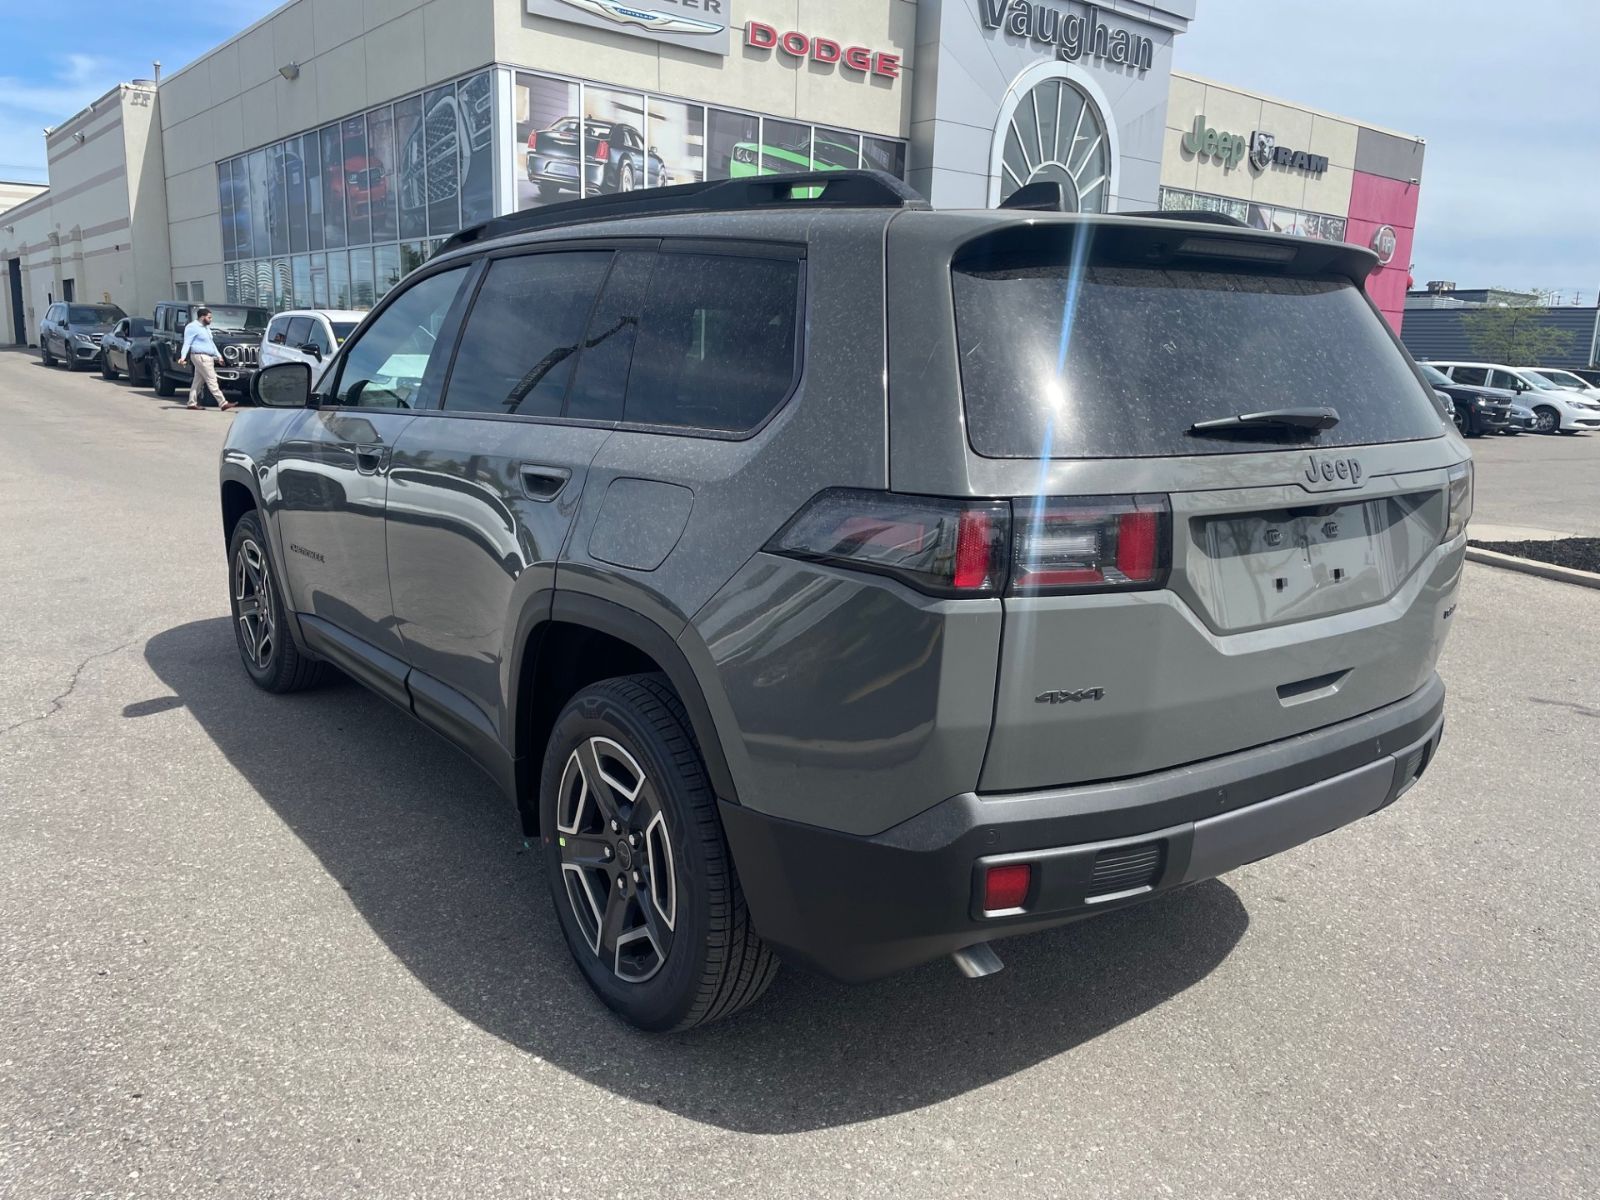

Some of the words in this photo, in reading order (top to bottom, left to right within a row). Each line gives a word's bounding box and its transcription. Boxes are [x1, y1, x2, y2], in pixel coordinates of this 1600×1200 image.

[745, 20, 900, 78] DODGE
[980, 0, 1153, 70] Vaughan
[1183, 115, 1246, 170] Jeep
[1274, 146, 1328, 173] RAM
[1305, 455, 1362, 484] Jeep
